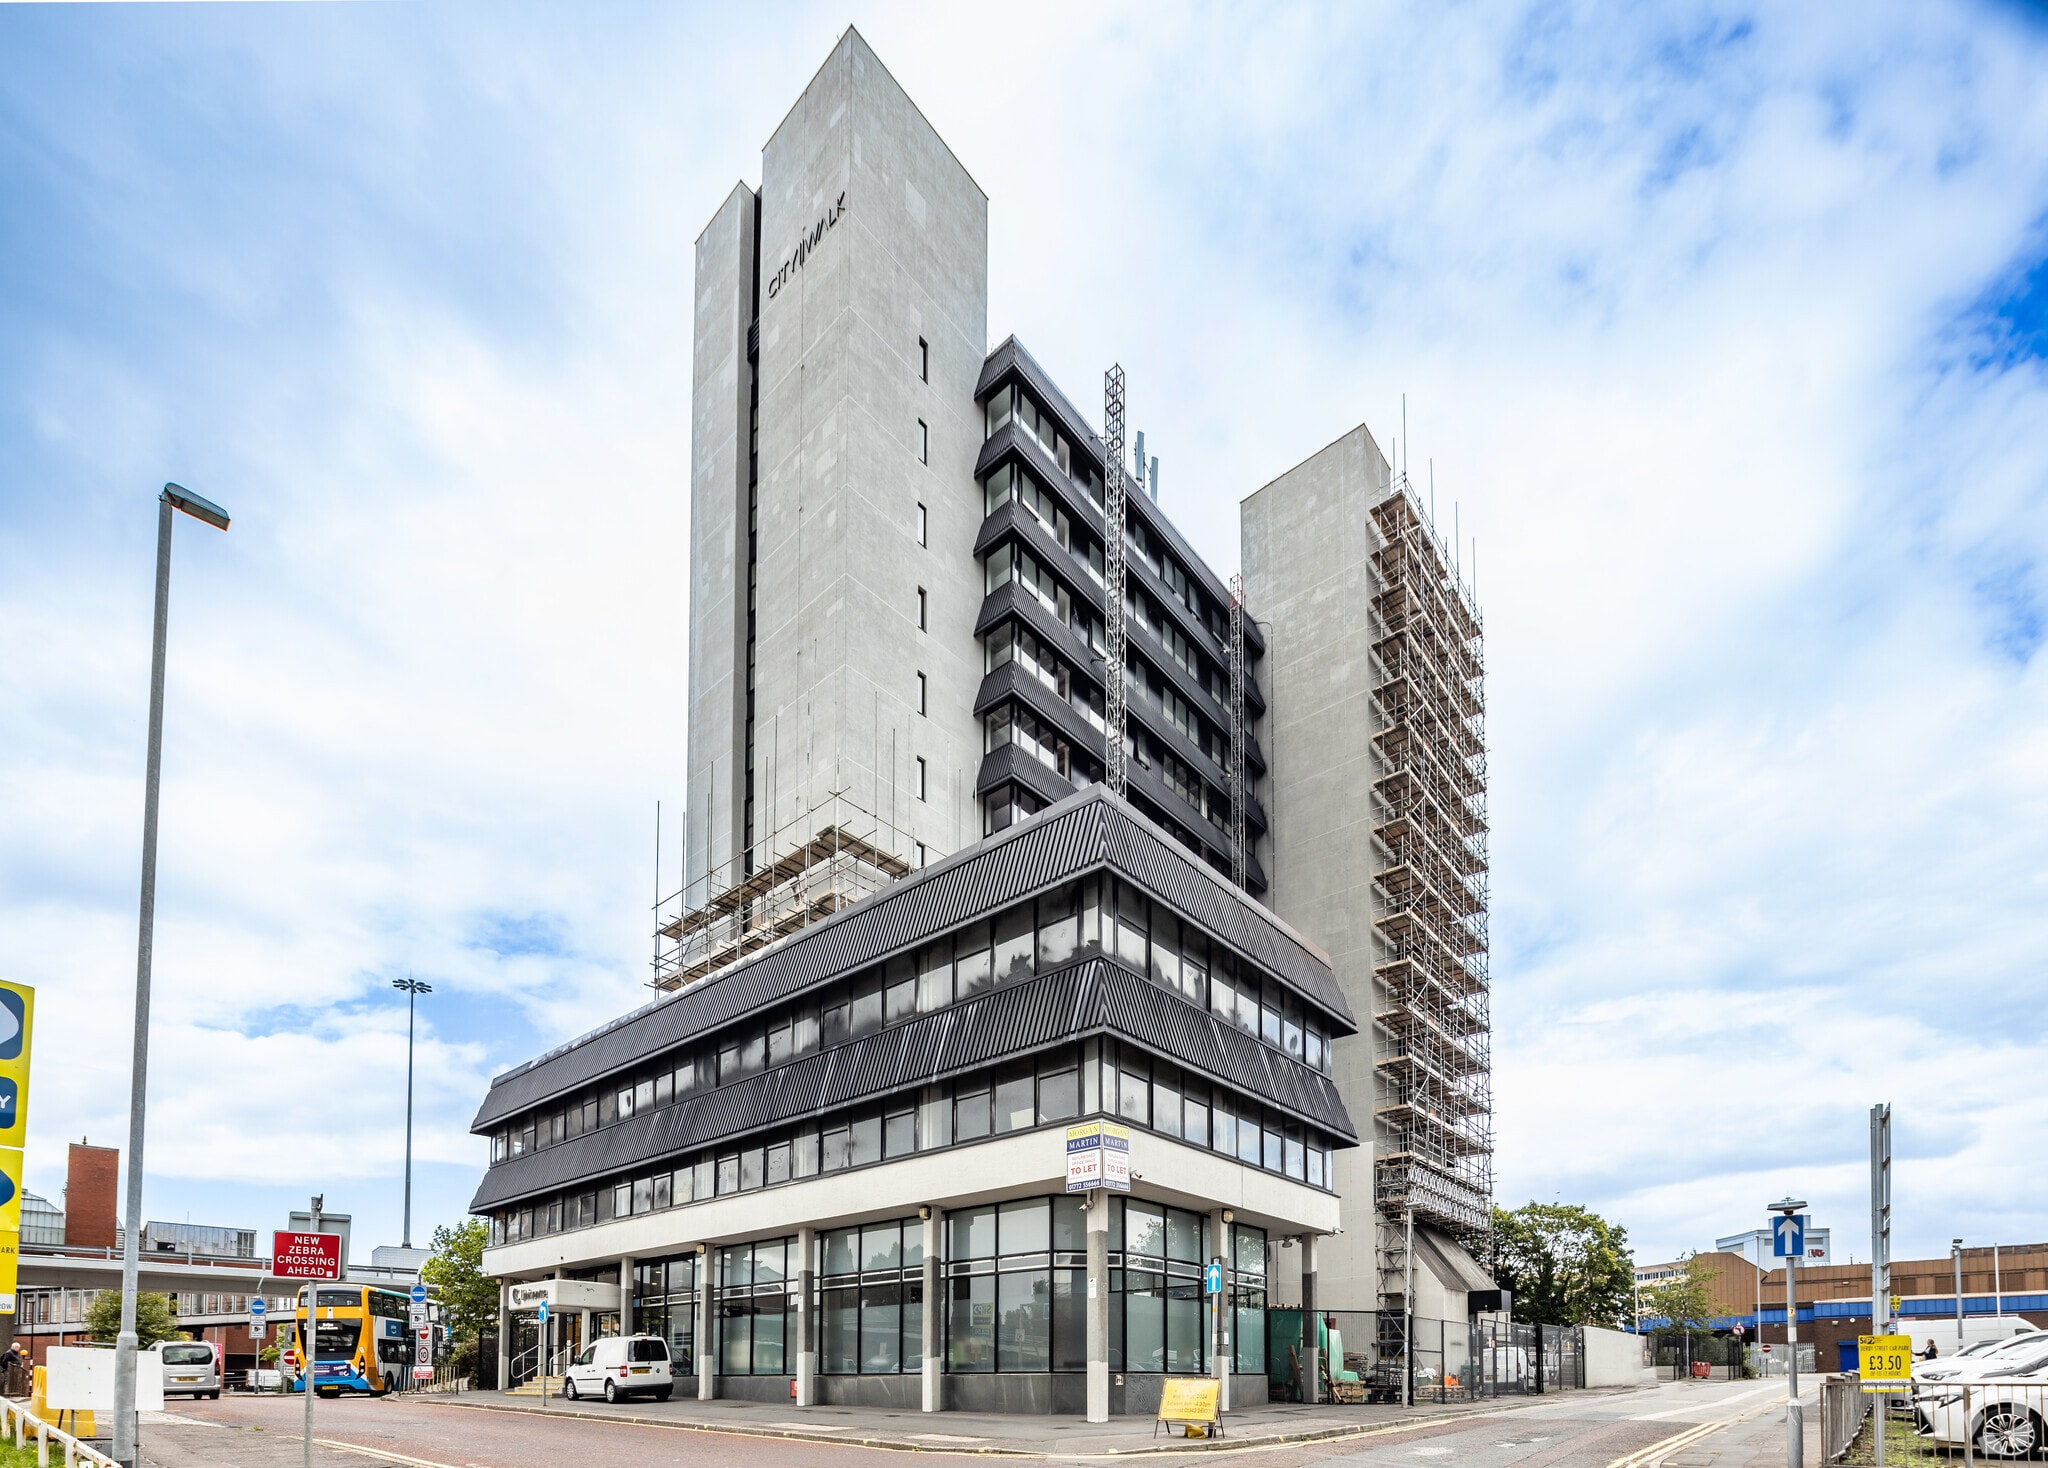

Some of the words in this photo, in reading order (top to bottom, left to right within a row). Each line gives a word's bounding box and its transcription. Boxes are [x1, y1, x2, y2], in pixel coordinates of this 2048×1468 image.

[1069, 1126, 1099, 1137] MORGAN
[1069, 1137, 1099, 1149] MARTIN
[1104, 1137, 1128, 1149] MARTIN
[1071, 1167, 1082, 1175] TO
[1083, 1164, 1097, 1173] LET
[1107, 1164, 1116, 1172] TO
[1116, 1166, 1127, 1175] LET
[294, 1236, 320, 1245] NEW
[289, 1245, 325, 1255] ZEBRA
[277, 1255, 335, 1266] CROSSING
[287, 1266, 325, 1276] AHEAD
[1869, 1355, 1902, 1370] £3.50
